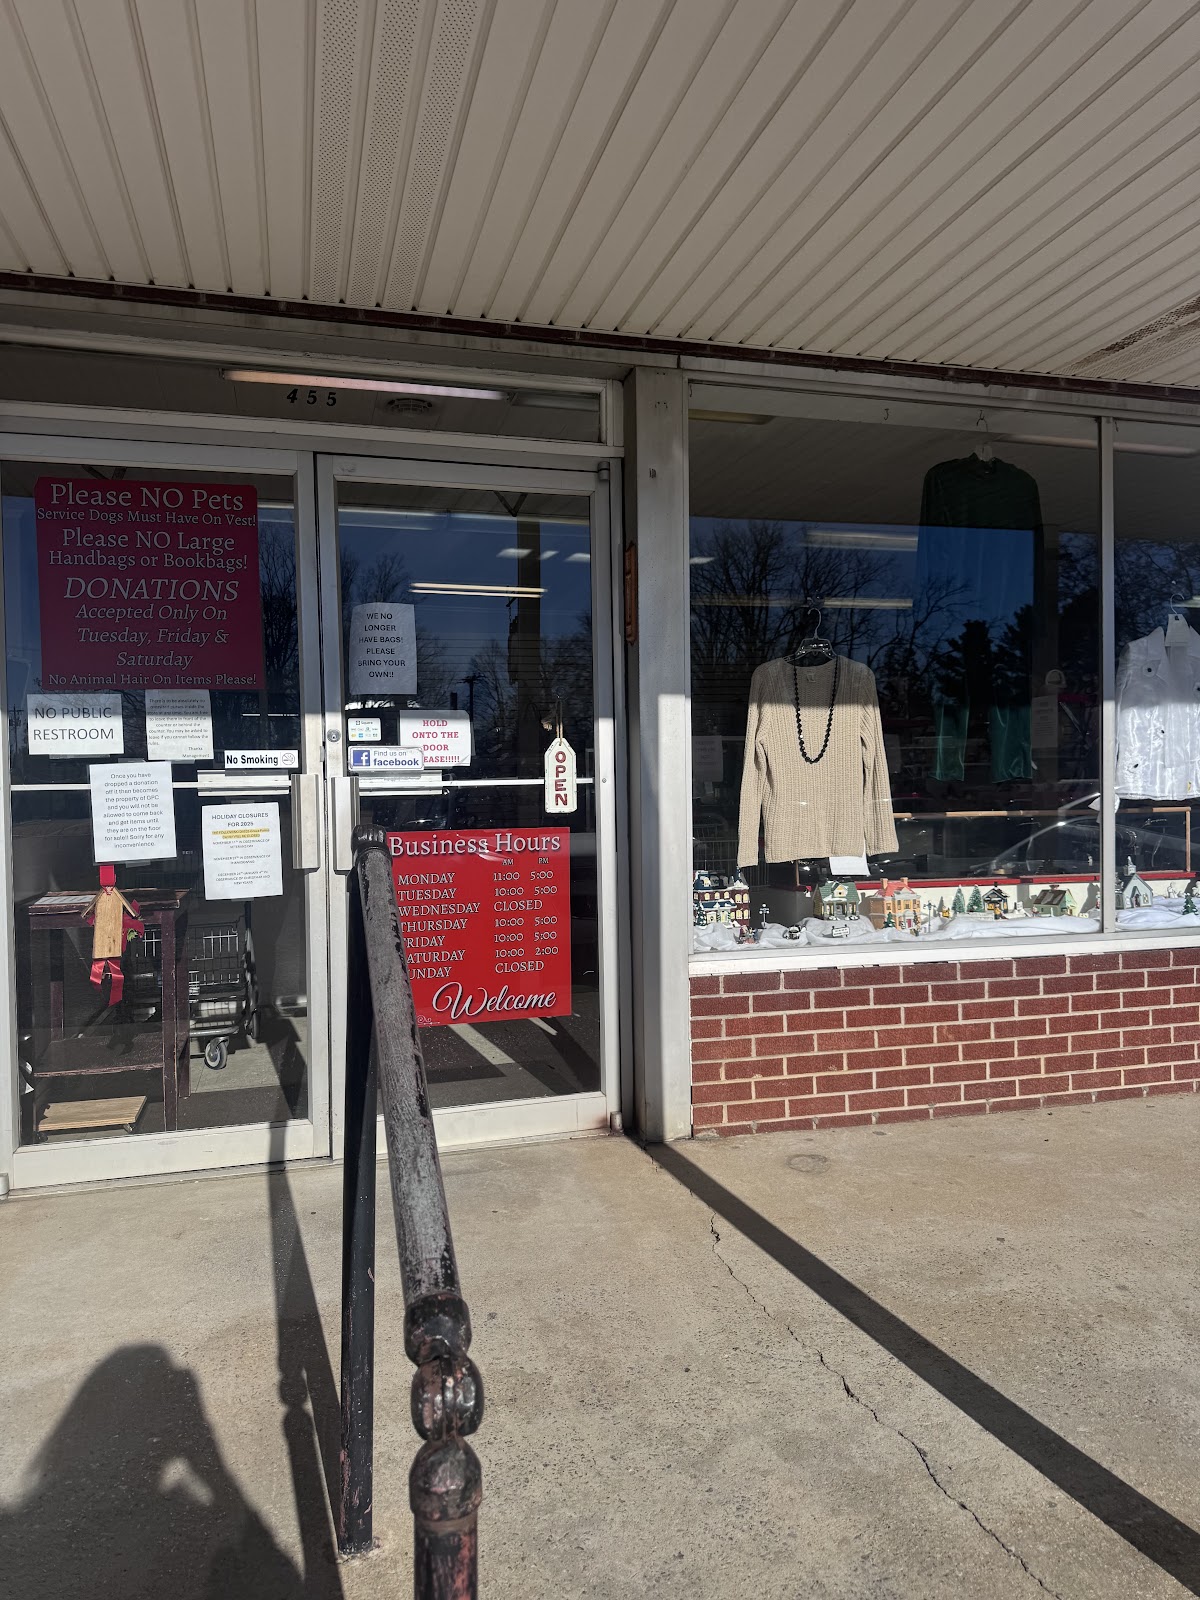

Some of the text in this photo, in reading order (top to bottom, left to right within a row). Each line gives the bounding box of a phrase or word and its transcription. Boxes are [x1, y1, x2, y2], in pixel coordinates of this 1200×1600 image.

[287, 389, 337, 406] 455
[50, 482, 244, 511] Please NO Pets
[37, 508, 256, 527] Service Dogs Must Have On Vest!
[62, 529, 235, 555] Please NO Large
[49, 551, 248, 573] Handbags or Bookbags!
[63, 577, 239, 602] DONATIONS
[75, 604, 228, 624] Accepted Only On
[77, 627, 229, 647] Tuesday, Friday &
[116, 652, 194, 670] Saturday
[48, 674, 256, 685] No Animal Hair On Items Please!
[34, 707, 112, 719] NO PUBLIC
[33, 728, 114, 740] RESTROOM
[226, 754, 279, 766] No Smoking
[374, 758, 419, 766] facebook
[555, 751, 568, 806] OPEN
[389, 833, 561, 856] Business Hours
[398, 871, 554, 886] MONDAY 11:00 5:00
[398, 886, 557, 901] TUESDAY 10:00 5:00
[399, 900, 543, 917] WEDNESDAY CLOSED
[495, 918, 524, 927] 10:00
[534, 917, 557, 926] 5:00
[404, 931, 557, 948] RIDAY 10:00 5:00
[407, 947, 559, 964] ATURDAY 10:00 2:00
[409, 961, 545, 979] UNDAY CLOSED
[432, 982, 556, 1020] Welcome
